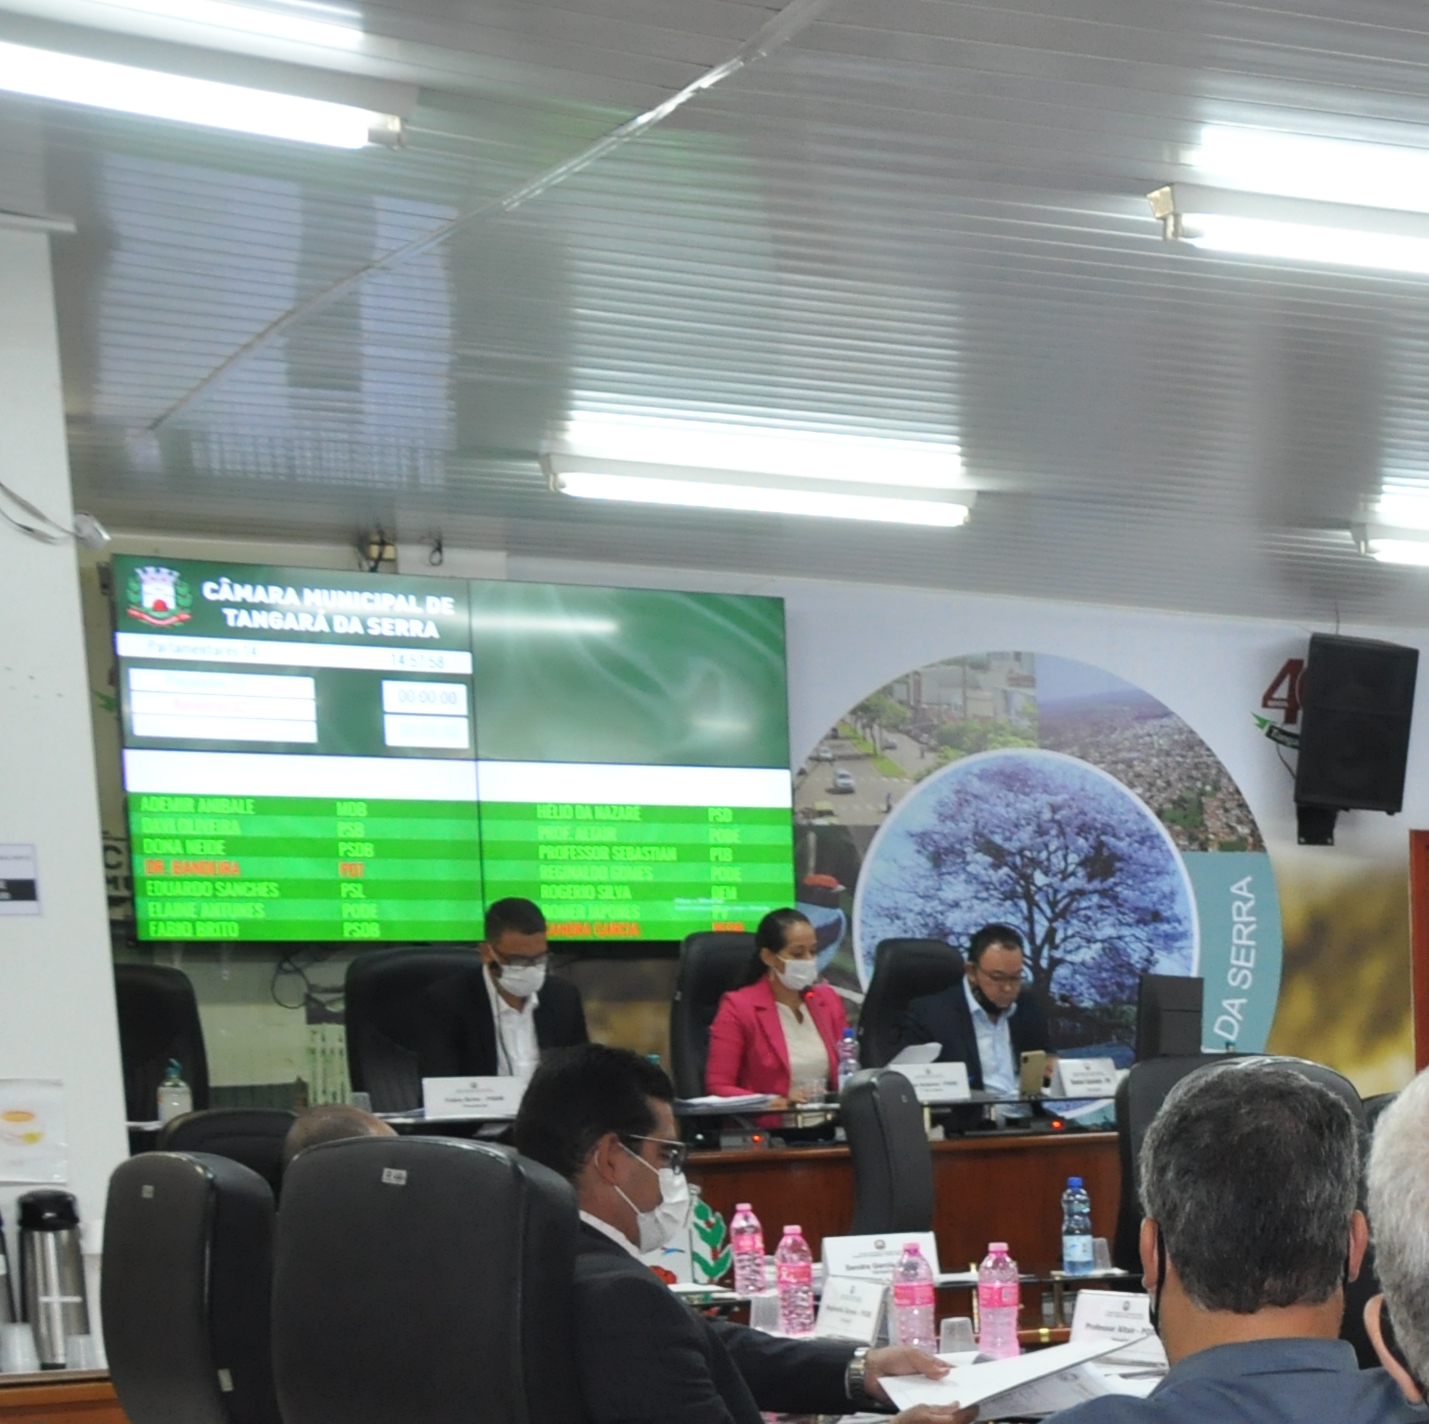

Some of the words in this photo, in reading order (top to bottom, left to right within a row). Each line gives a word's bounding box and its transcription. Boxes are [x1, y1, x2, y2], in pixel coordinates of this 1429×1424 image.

[202, 577, 300, 606] CÂMARA
[301, 587, 421, 614] MUNICIPAL
[425, 596, 455, 615] DE
[221, 607, 331, 633] TANGARÁ
[333, 615, 365, 634] DA
[367, 617, 440, 638] SERRA
[140, 796, 194, 813] ADEMIR
[575, 805, 592, 820] DA
[143, 838, 183, 854] DONA
[538, 845, 610, 860] PROFESSOR
[145, 880, 212, 896] EDUARDO
[214, 881, 279, 897] SANCHES
[597, 885, 632, 900] SILVA
[1227, 875, 1257, 990] SERRA
[1213, 998, 1248, 1041] DA
